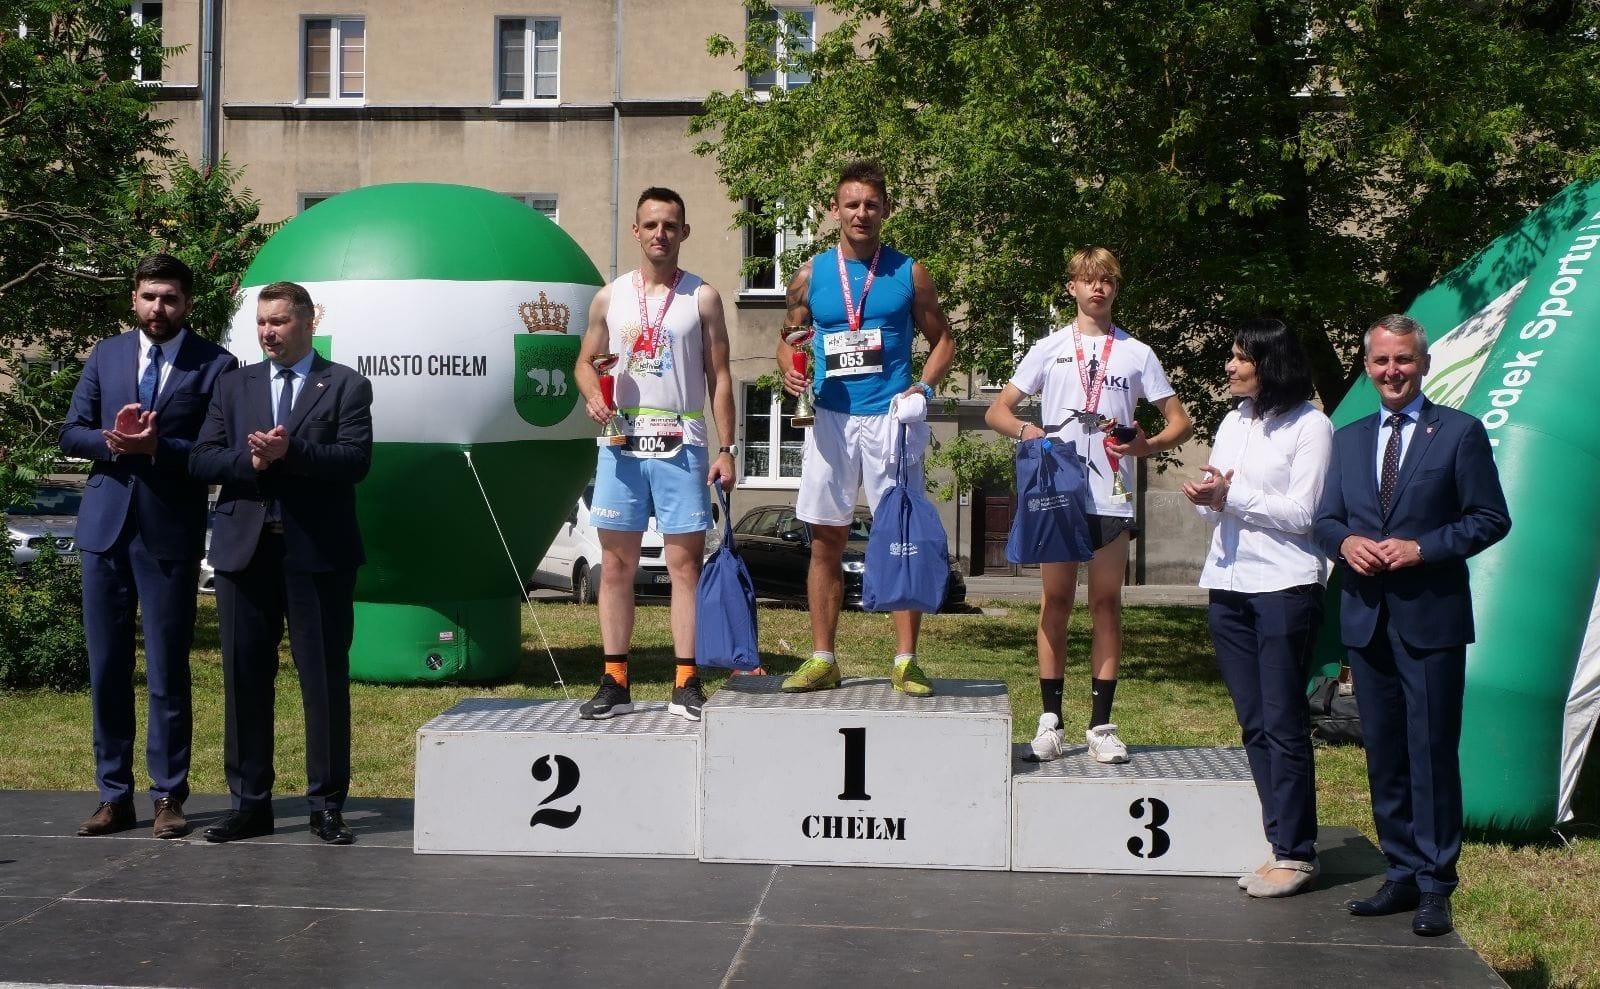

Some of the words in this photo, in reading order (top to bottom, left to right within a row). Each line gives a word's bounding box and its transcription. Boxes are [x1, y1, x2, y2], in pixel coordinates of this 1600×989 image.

[839, 351, 864, 368] 053
[1482, 350, 1543, 448] odek
[1519, 234, 1600, 340] Sportu
[357, 354, 423, 377] MIASTO
[427, 355, 487, 377] CHEŁM
[639, 436, 666, 452] 004
[838, 728, 873, 801] 1
[530, 754, 582, 829] 2
[801, 815, 907, 841] CHEŁM
[1127, 797, 1170, 858] 3
